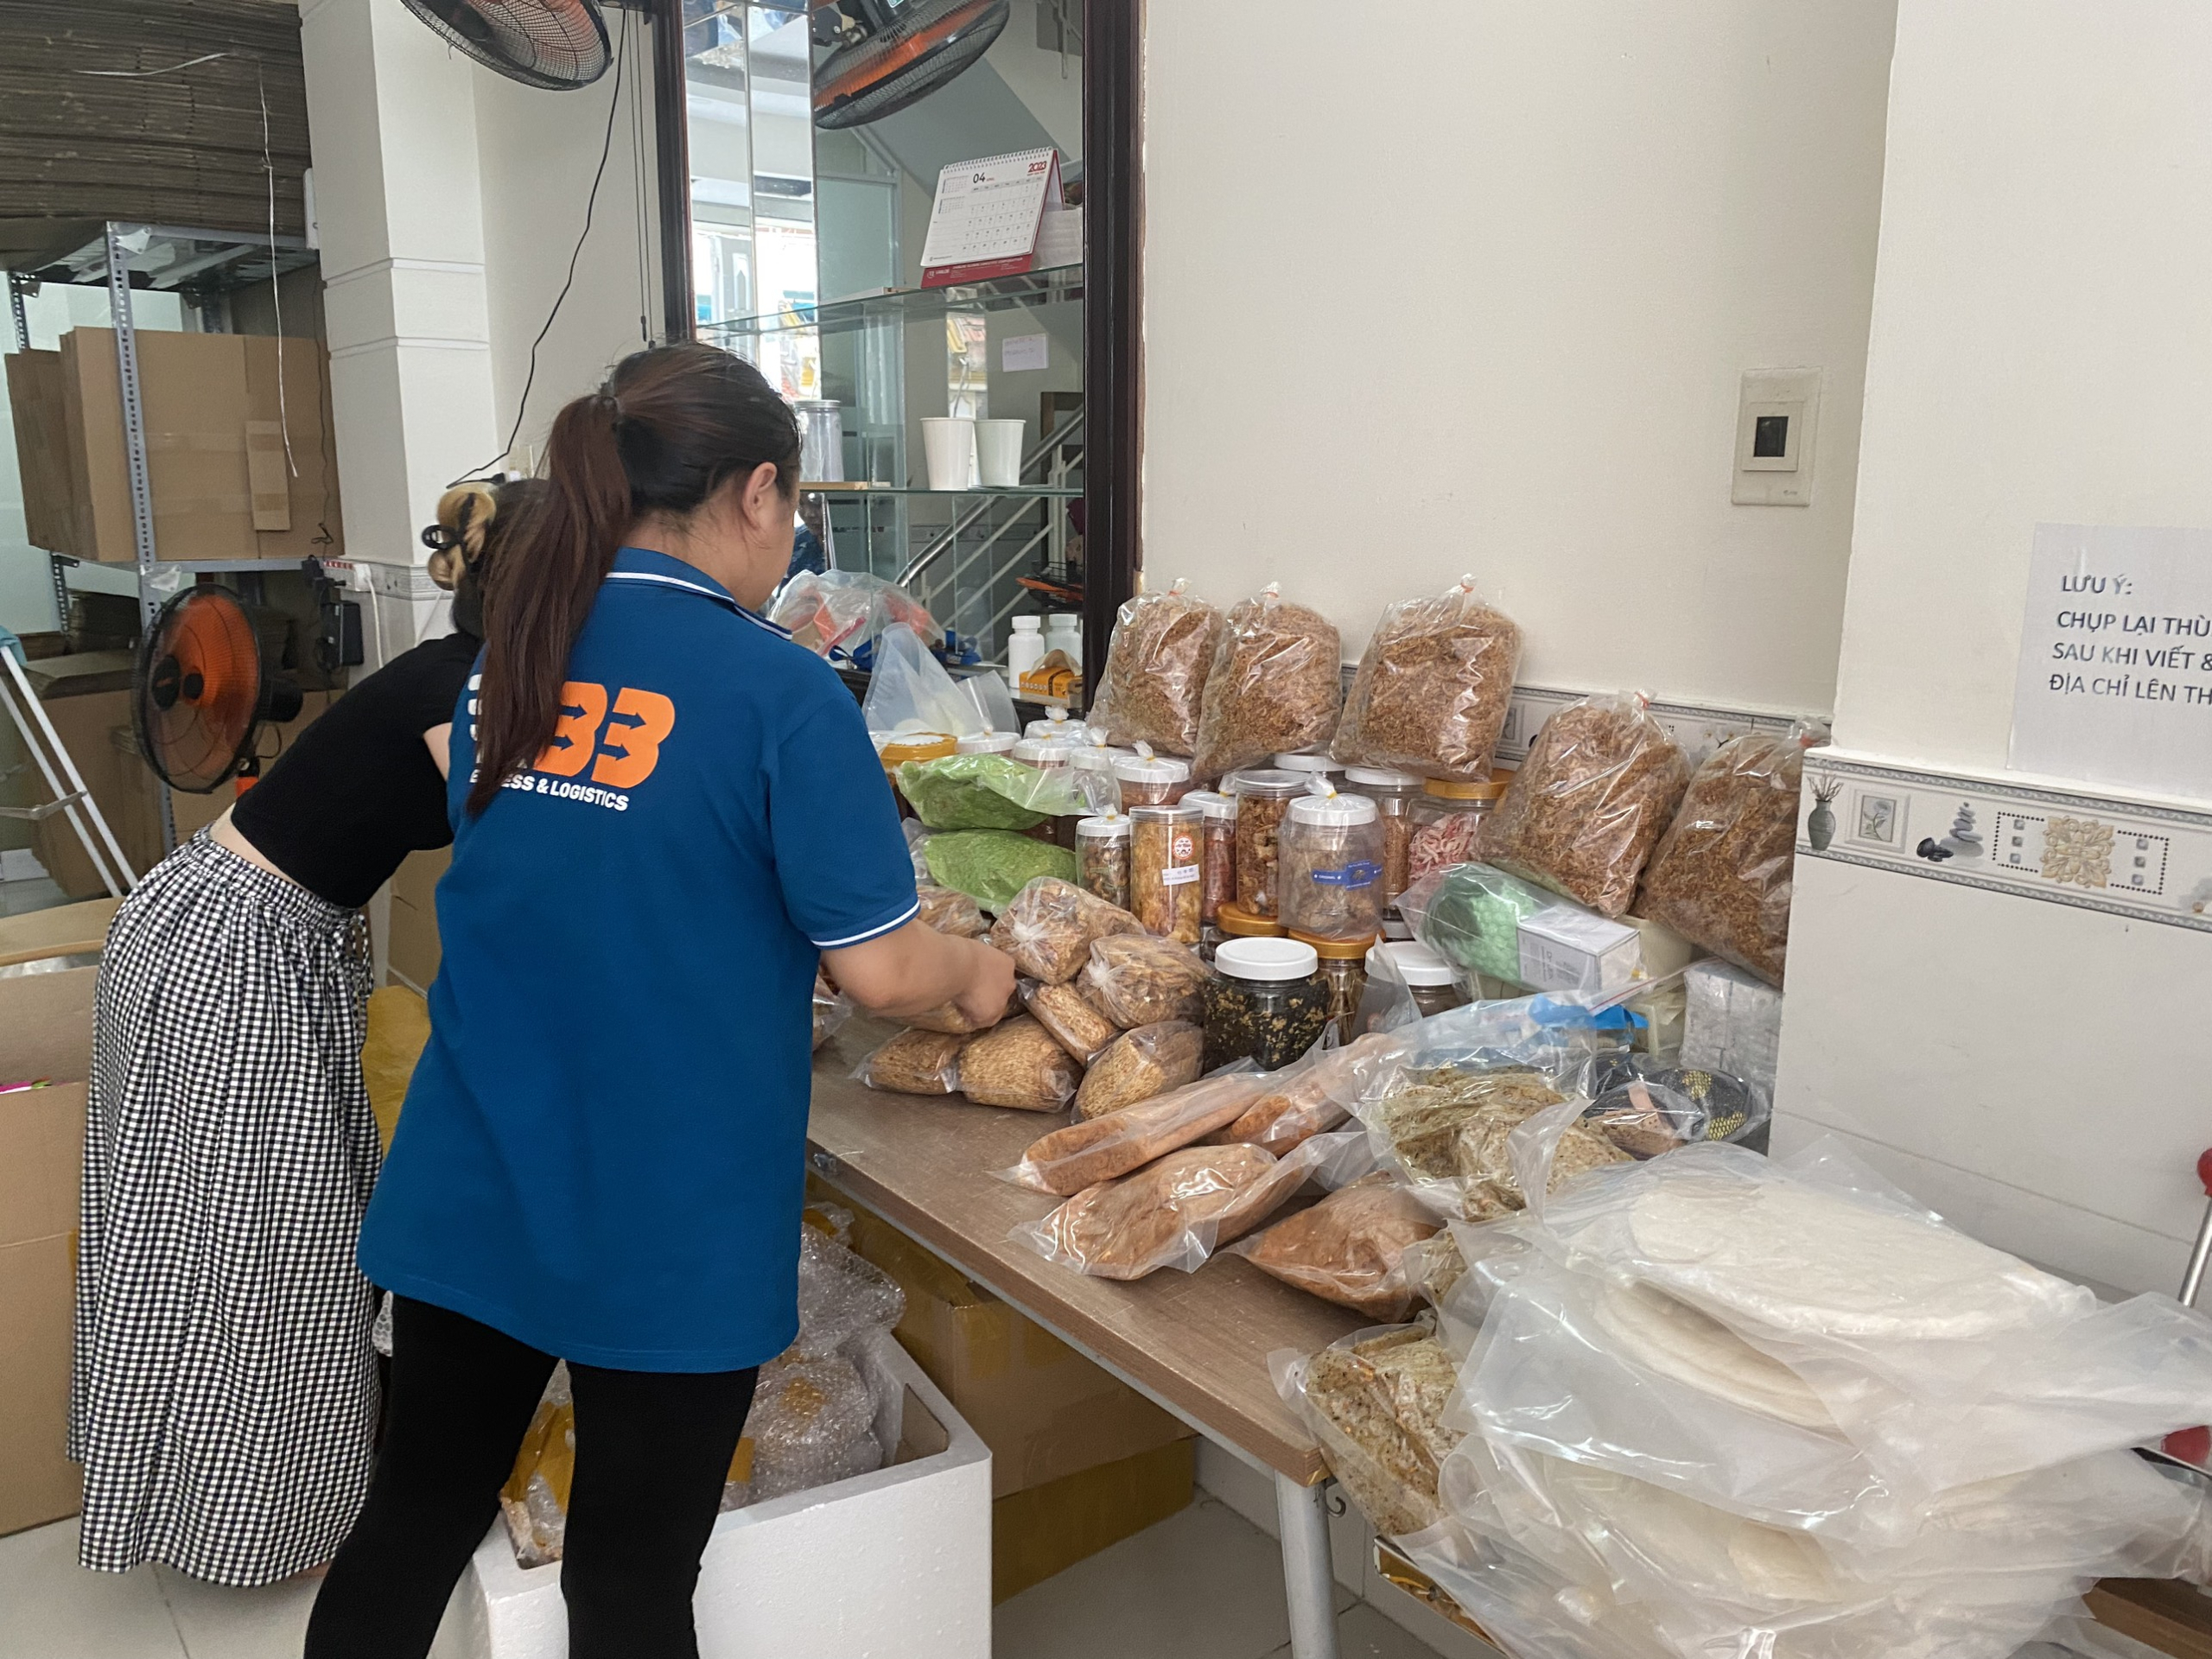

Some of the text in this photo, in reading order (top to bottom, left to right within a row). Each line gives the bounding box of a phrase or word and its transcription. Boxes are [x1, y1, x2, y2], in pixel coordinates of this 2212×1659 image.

[972, 172, 986, 184] 04
[1027, 161, 1047, 173] 2023
[2061, 574, 2133, 595] LƯU Ý:
[2056, 610, 2212, 637] CHỤP LẠI THÙ
[2052, 641, 2095, 663] SAU
[2101, 645, 2139, 666] KHI
[2145, 645, 2196, 671] VIẾT
[2092, 674, 2131, 697] CHỈ
[2135, 677, 2177, 702] LÊN
[536, 777, 550, 795] &
[550, 779, 630, 812] LOGISTICS
